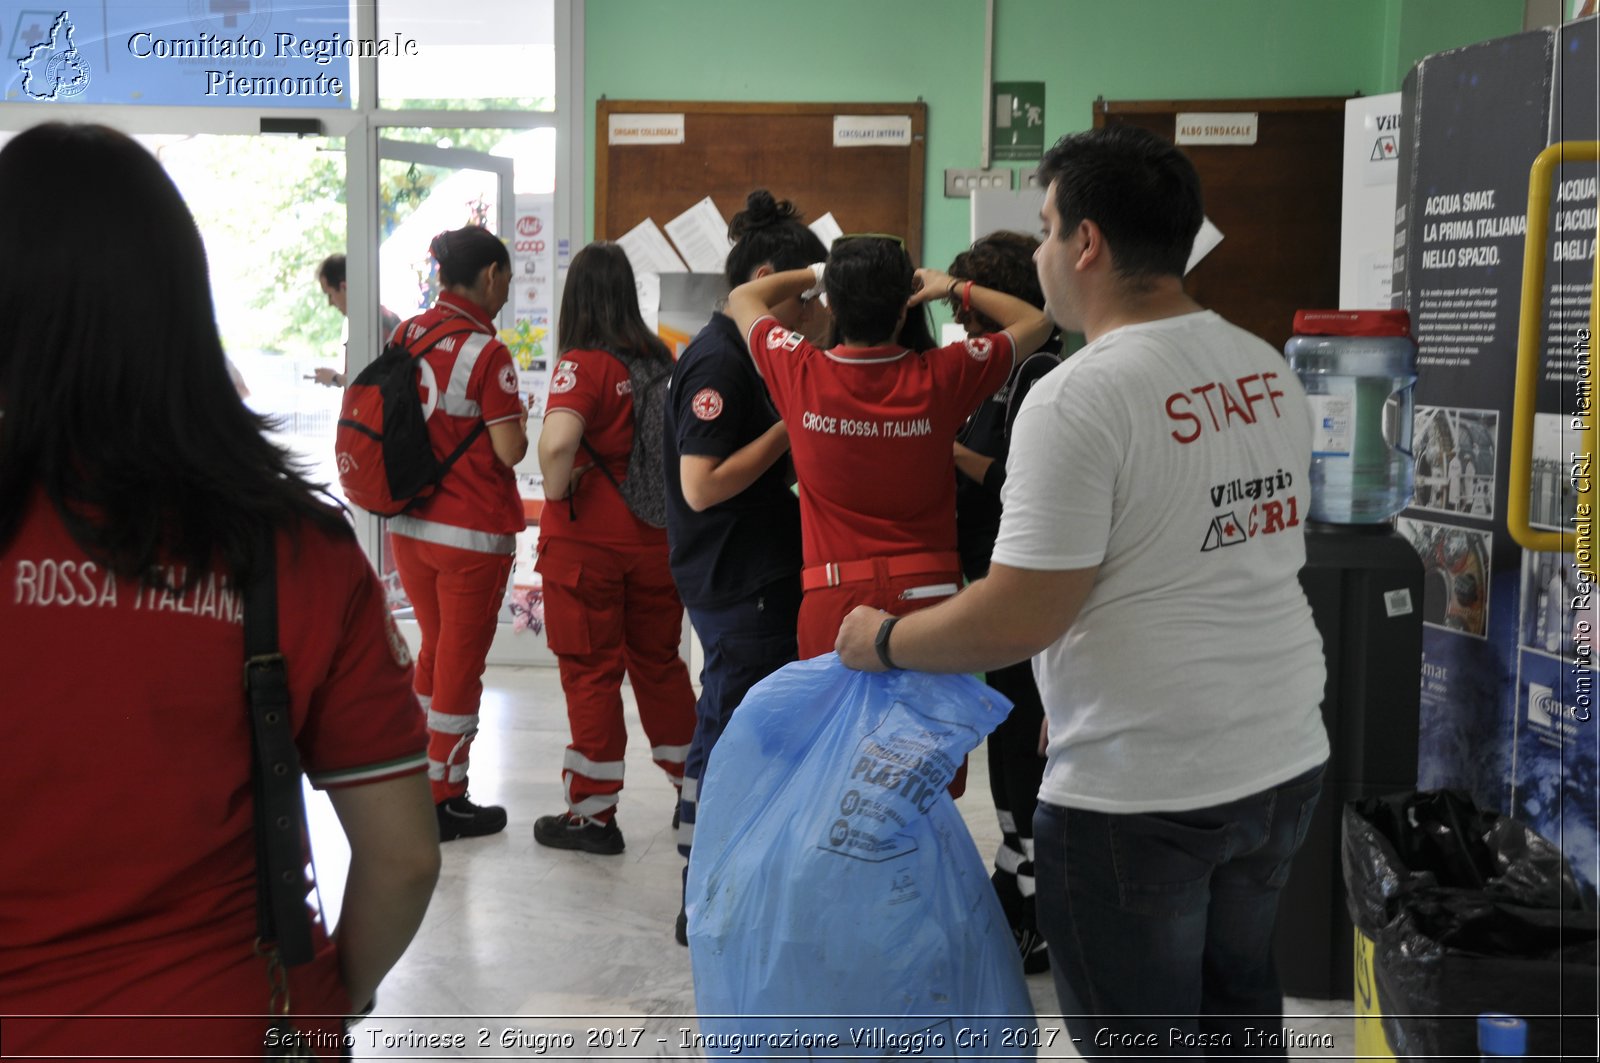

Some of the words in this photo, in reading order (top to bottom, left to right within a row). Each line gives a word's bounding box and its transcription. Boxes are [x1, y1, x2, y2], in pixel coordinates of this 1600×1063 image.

[614, 128, 639, 137] ORGANI
[838, 129, 874, 139] CIRCOLARI
[1181, 125, 1202, 137] ALBO
[1204, 125, 1251, 137] SINDACALE
[1425, 193, 1460, 216] ACQUA
[1463, 190, 1495, 212] SMAT.
[1556, 177, 1596, 203] ACQUA
[1423, 223, 1437, 243] LA
[1439, 219, 1473, 241] PRIMA
[1475, 215, 1527, 238] ITALIANA
[515, 240, 545, 256] coop
[1422, 249, 1456, 269] NELLO
[1458, 246, 1500, 267] SPAZIO.
[1553, 240, 1586, 262] DAGLI
[1165, 372, 1284, 444] STAFF
[802, 411, 837, 434] CROCE
[840, 419, 879, 437] ROSSA
[883, 418, 932, 438] ITALIANA
[1210, 468, 1293, 508] Villaggio
[1248, 495, 1300, 538] CRI
[15, 559, 117, 608] ROSSA
